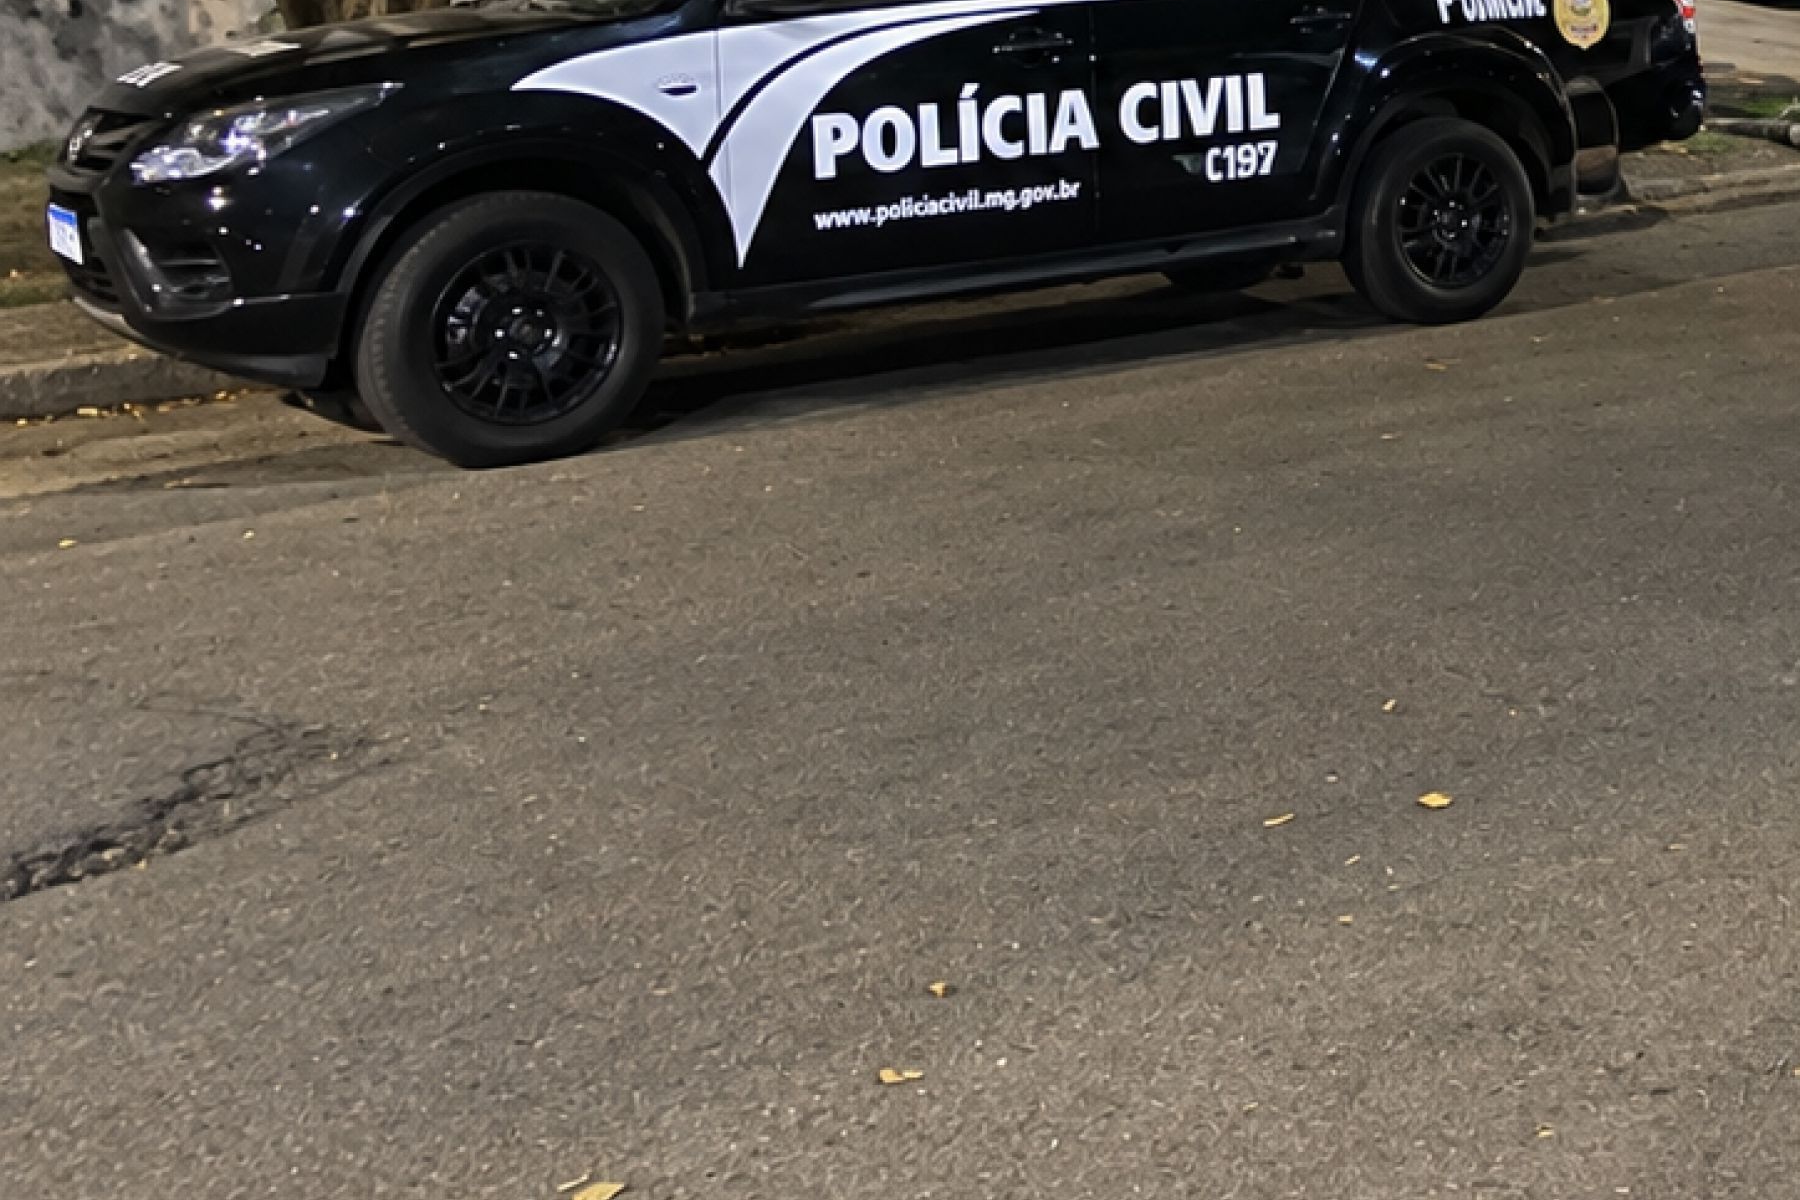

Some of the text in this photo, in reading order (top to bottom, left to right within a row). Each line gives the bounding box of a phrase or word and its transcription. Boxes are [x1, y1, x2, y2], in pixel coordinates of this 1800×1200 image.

[812, 72, 1280, 179] POLÍCIA CIVIL
[1206, 140, 1278, 182] C197
[814, 179, 1081, 230] www.policiacivil.mg.gov.br
